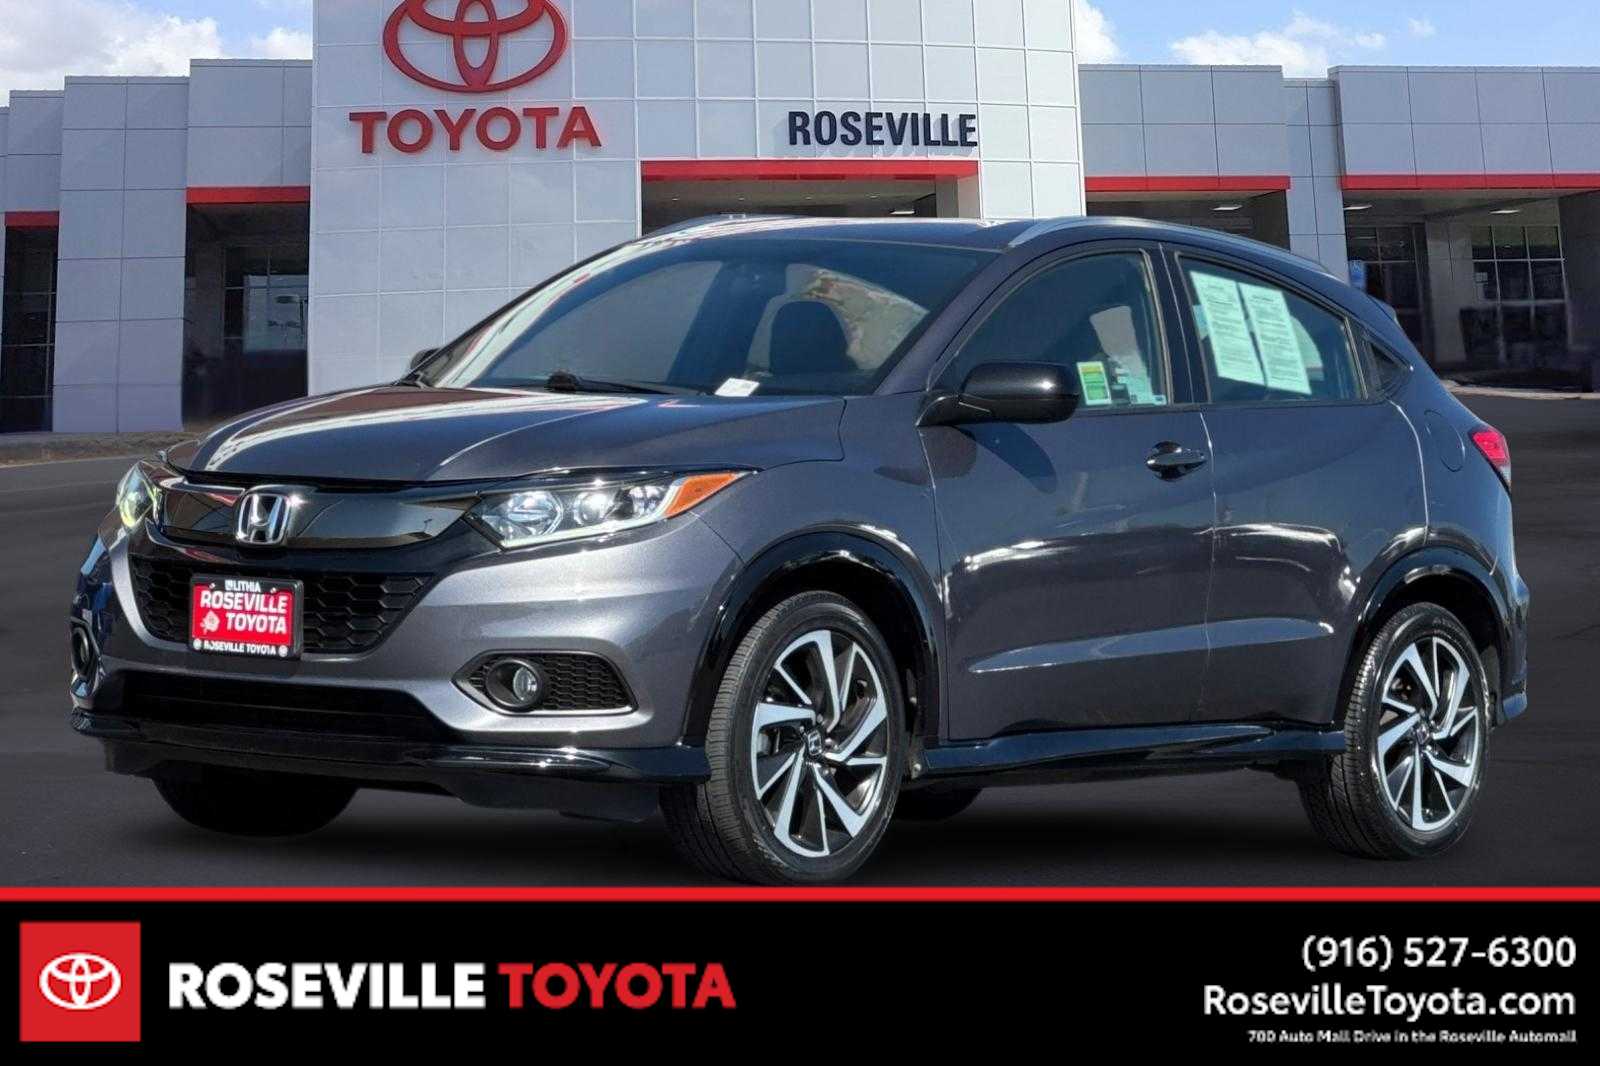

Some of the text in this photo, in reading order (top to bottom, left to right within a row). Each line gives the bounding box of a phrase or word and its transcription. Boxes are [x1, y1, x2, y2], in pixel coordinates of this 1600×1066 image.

[349, 105, 602, 154] TOYOTA
[788, 110, 979, 148] ROSEVILLE
[233, 580, 261, 593] LITHIA
[200, 590, 288, 614] ROSEVILLE
[226, 612, 288, 635] TOYOTA
